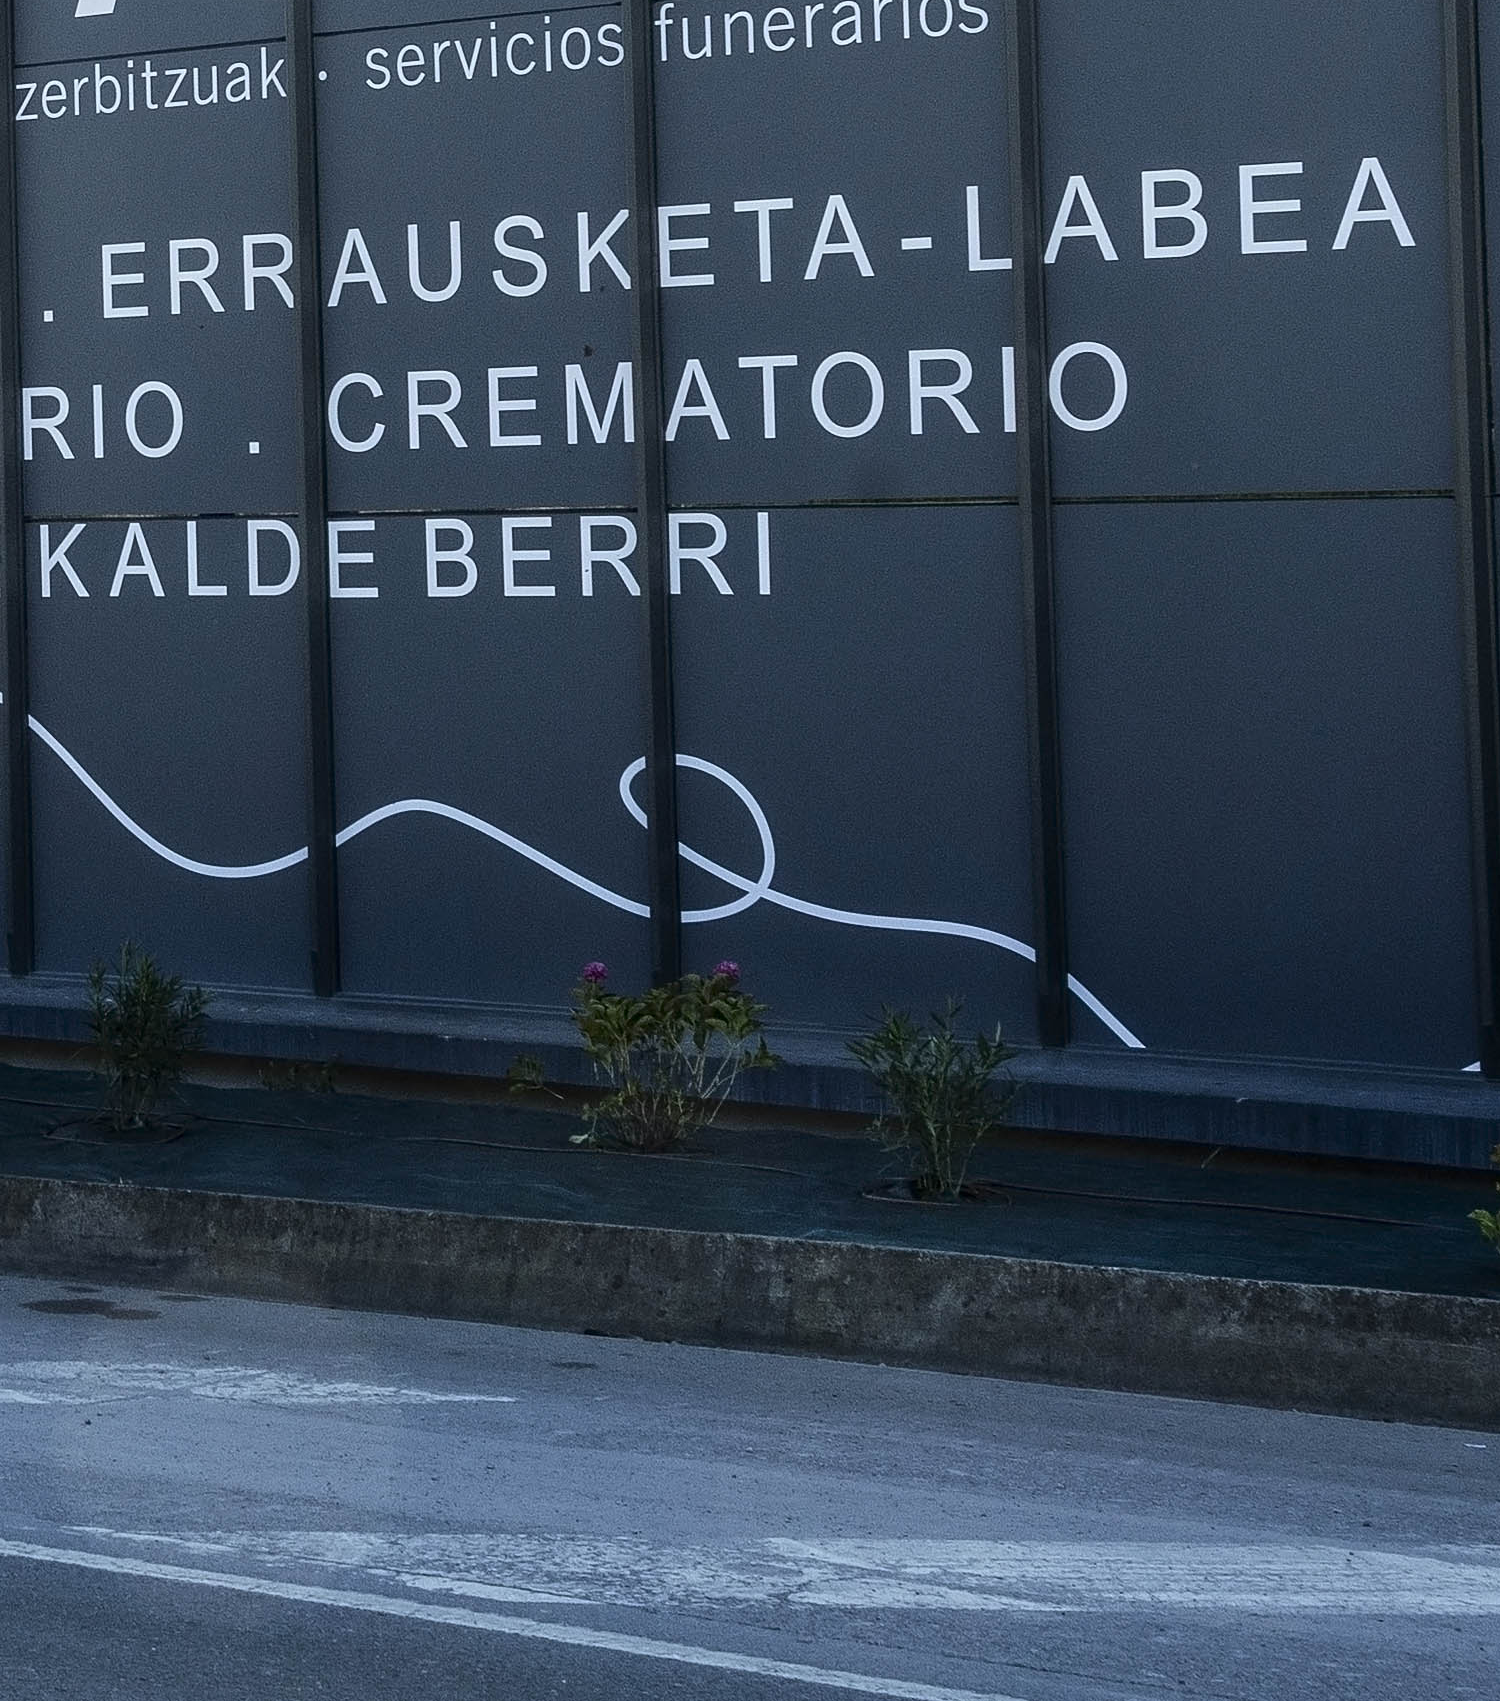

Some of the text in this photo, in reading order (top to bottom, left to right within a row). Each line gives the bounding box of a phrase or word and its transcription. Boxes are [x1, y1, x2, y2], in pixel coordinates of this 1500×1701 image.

[15, 46, 288, 121] zerbitzuak
[366, 23, 626, 90] servicios
[327, 341, 1128, 453] CREMATORIO
